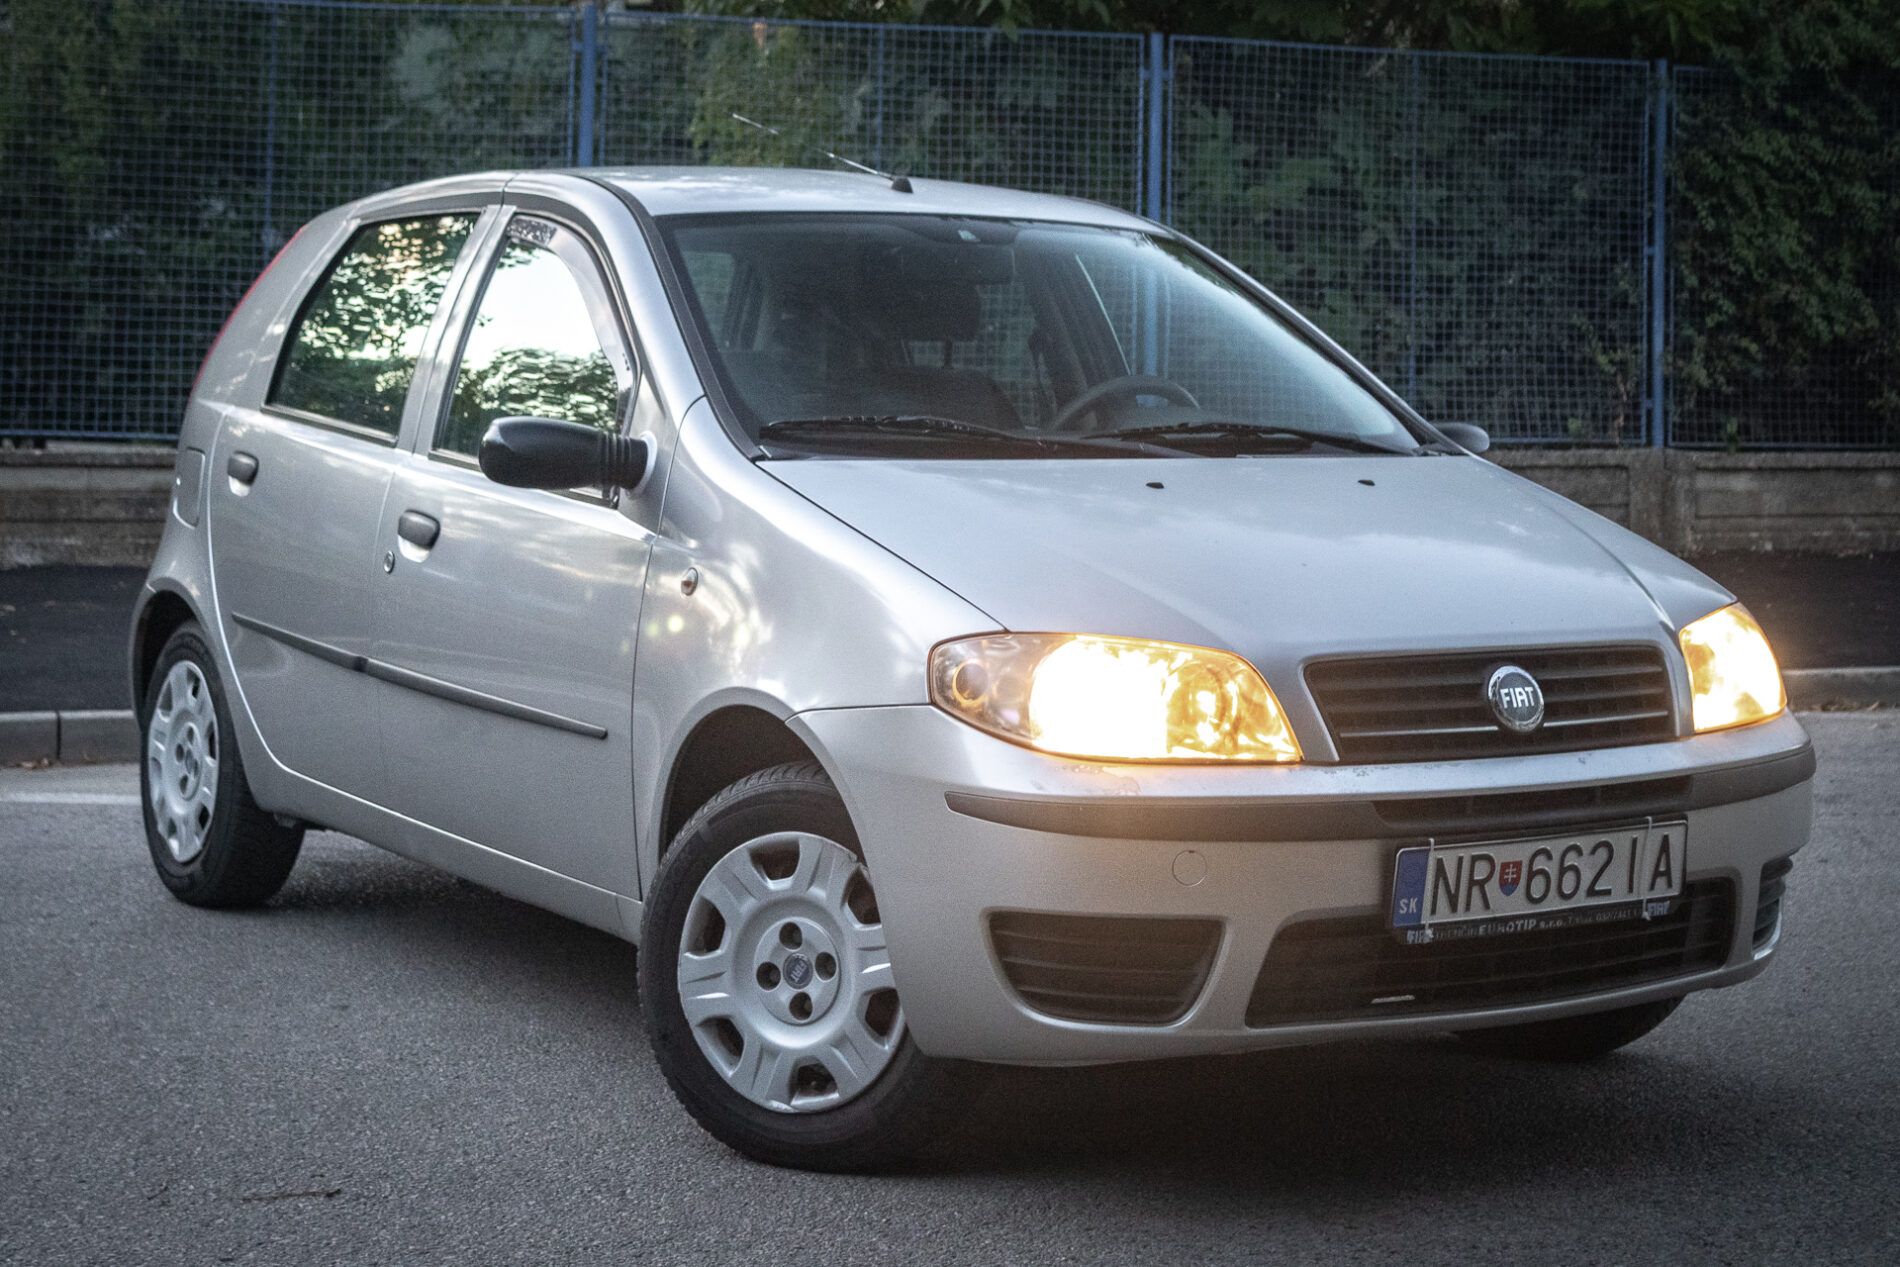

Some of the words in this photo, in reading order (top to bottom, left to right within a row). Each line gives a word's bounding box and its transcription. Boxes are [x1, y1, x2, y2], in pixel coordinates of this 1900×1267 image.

[1500, 687, 1535, 709] FIAT
[1430, 852, 1496, 915] NR
[1399, 897, 1418, 914] SK
